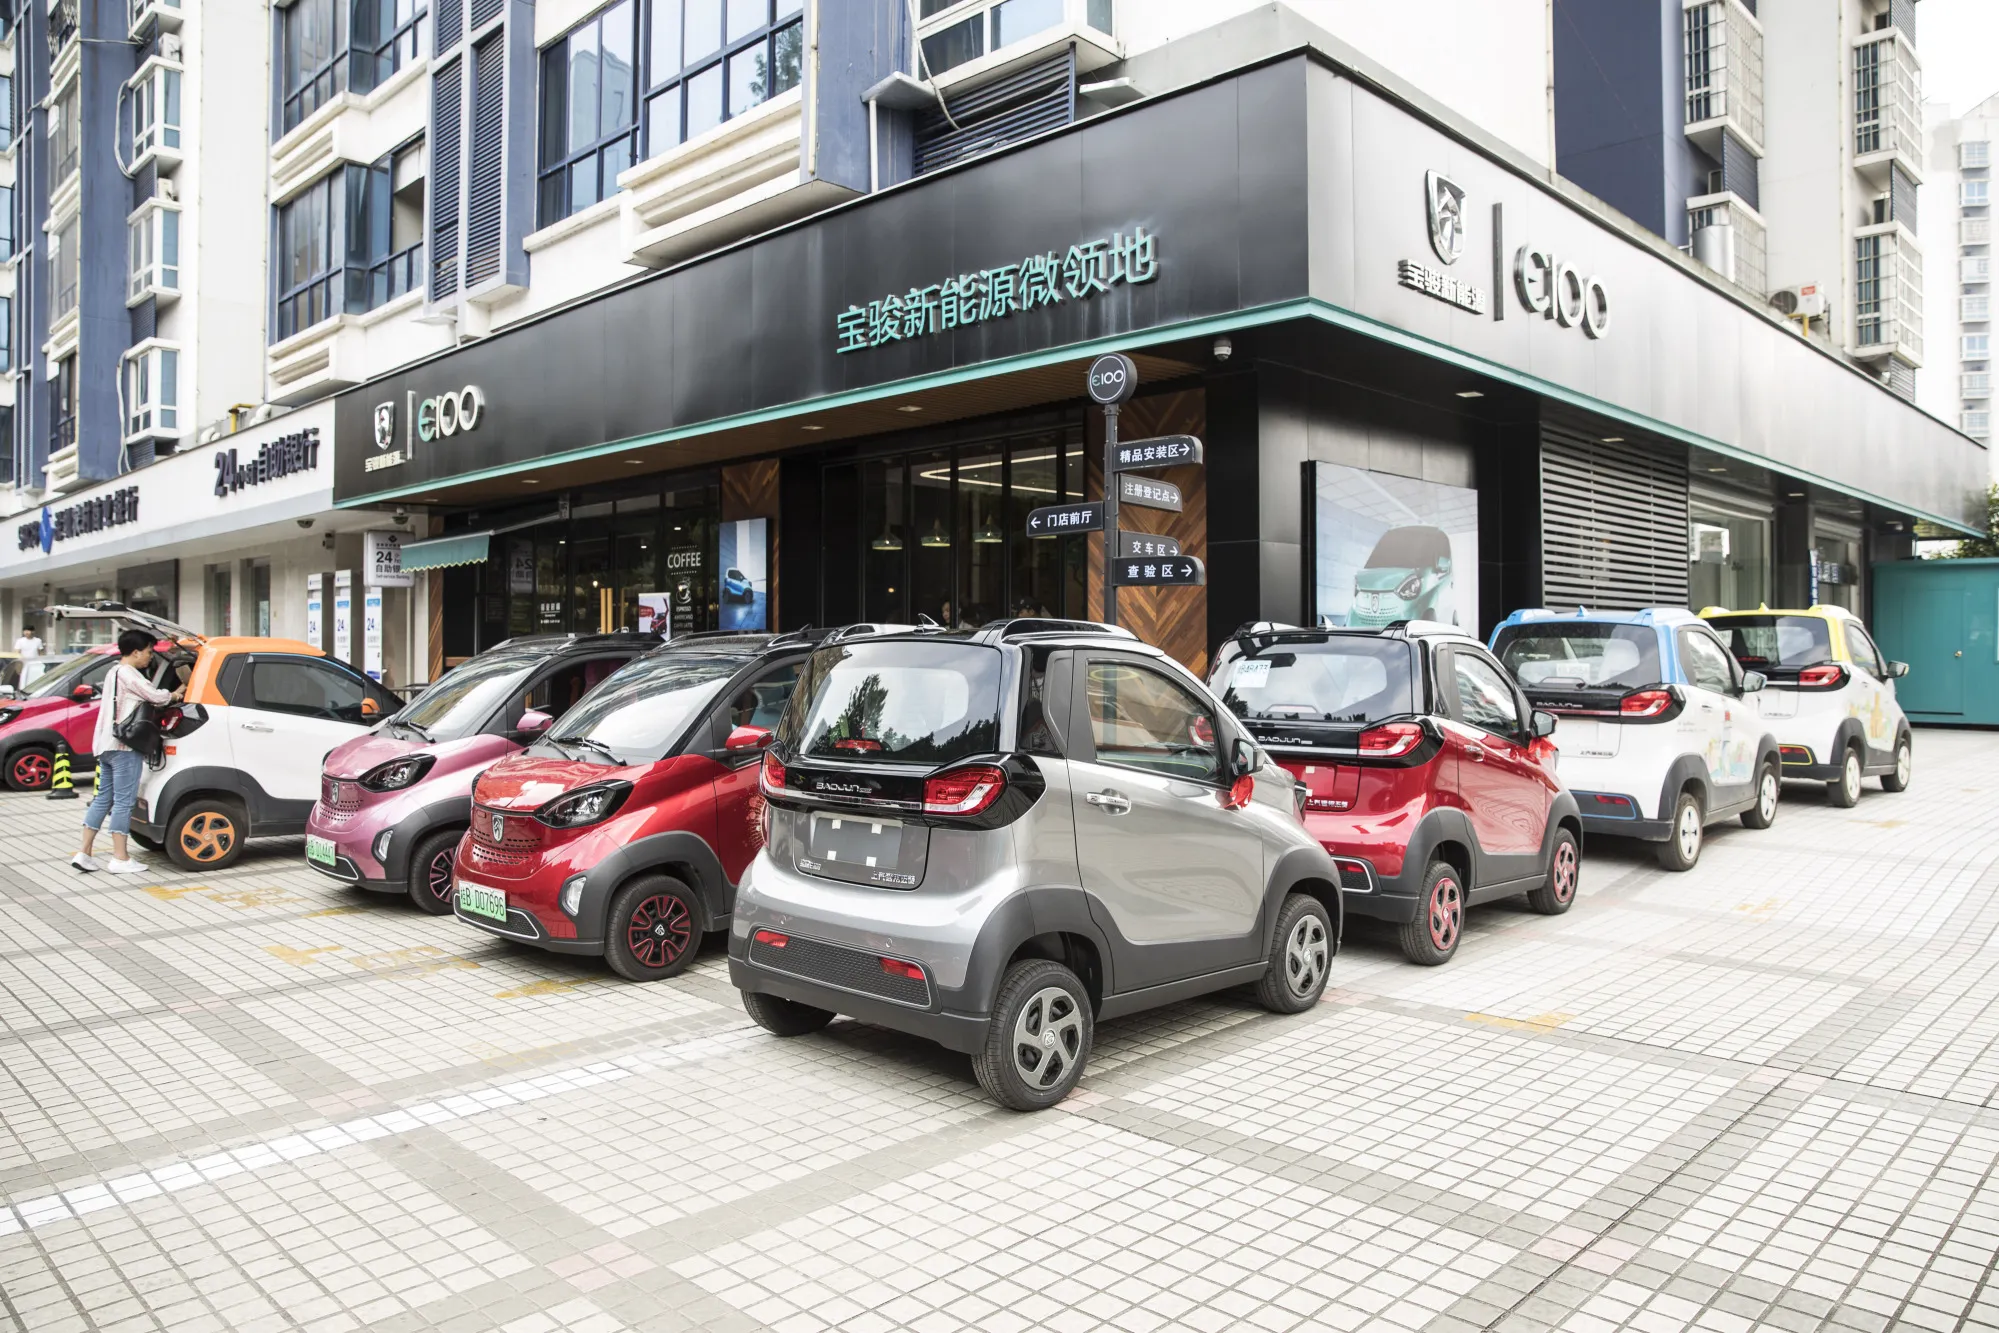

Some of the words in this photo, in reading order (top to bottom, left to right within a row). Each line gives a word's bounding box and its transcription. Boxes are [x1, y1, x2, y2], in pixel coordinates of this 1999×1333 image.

[837, 226, 1159, 354] 宝骏新能源微领地
[1119, 443, 1180, 464] 精品安装区
[1124, 483, 1171, 503] 注册登记点
[1047, 510, 1092, 528] 门店前厅
[1132, 541, 1166, 556] 交车区
[376, 551, 393, 563] 24
[667, 552, 702, 569] COFFEE
[1127, 565, 1174, 578] 查验区
[338, 619, 345, 631] 24
[367, 618, 375, 631] 24
